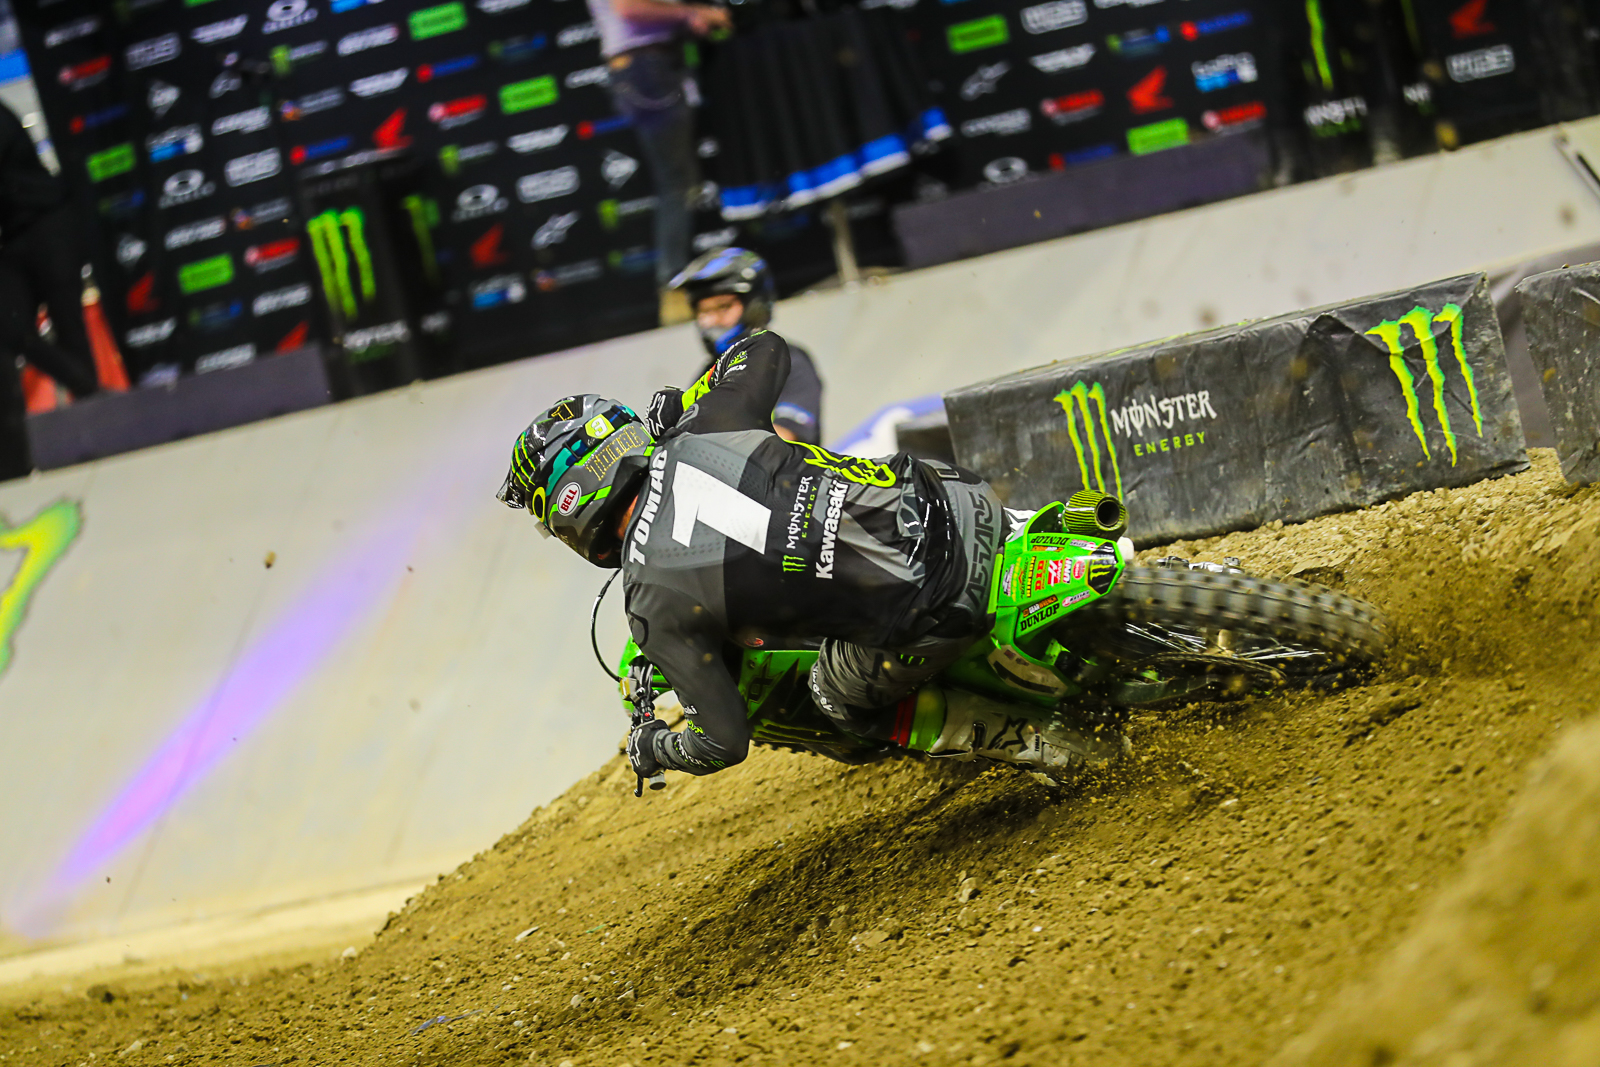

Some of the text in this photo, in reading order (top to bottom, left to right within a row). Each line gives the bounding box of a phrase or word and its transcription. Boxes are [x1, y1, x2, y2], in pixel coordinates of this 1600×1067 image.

[1110, 390, 1217, 438] MONSTER
[585, 425, 645, 481] TOMAC
[1132, 431, 1205, 457] ENERGY
[560, 489, 578, 512] BELL
[629, 449, 668, 566] TOMAC
[671, 461, 772, 555] 1
[786, 476, 814, 549] MONSTER
[801, 486, 817, 538] ENERGY
[815, 479, 849, 579] Kawasaki
[1030, 535, 1070, 546] DUNLOP
[1063, 558, 1072, 583] UNI
[1020, 603, 1060, 631] DUNLOP
